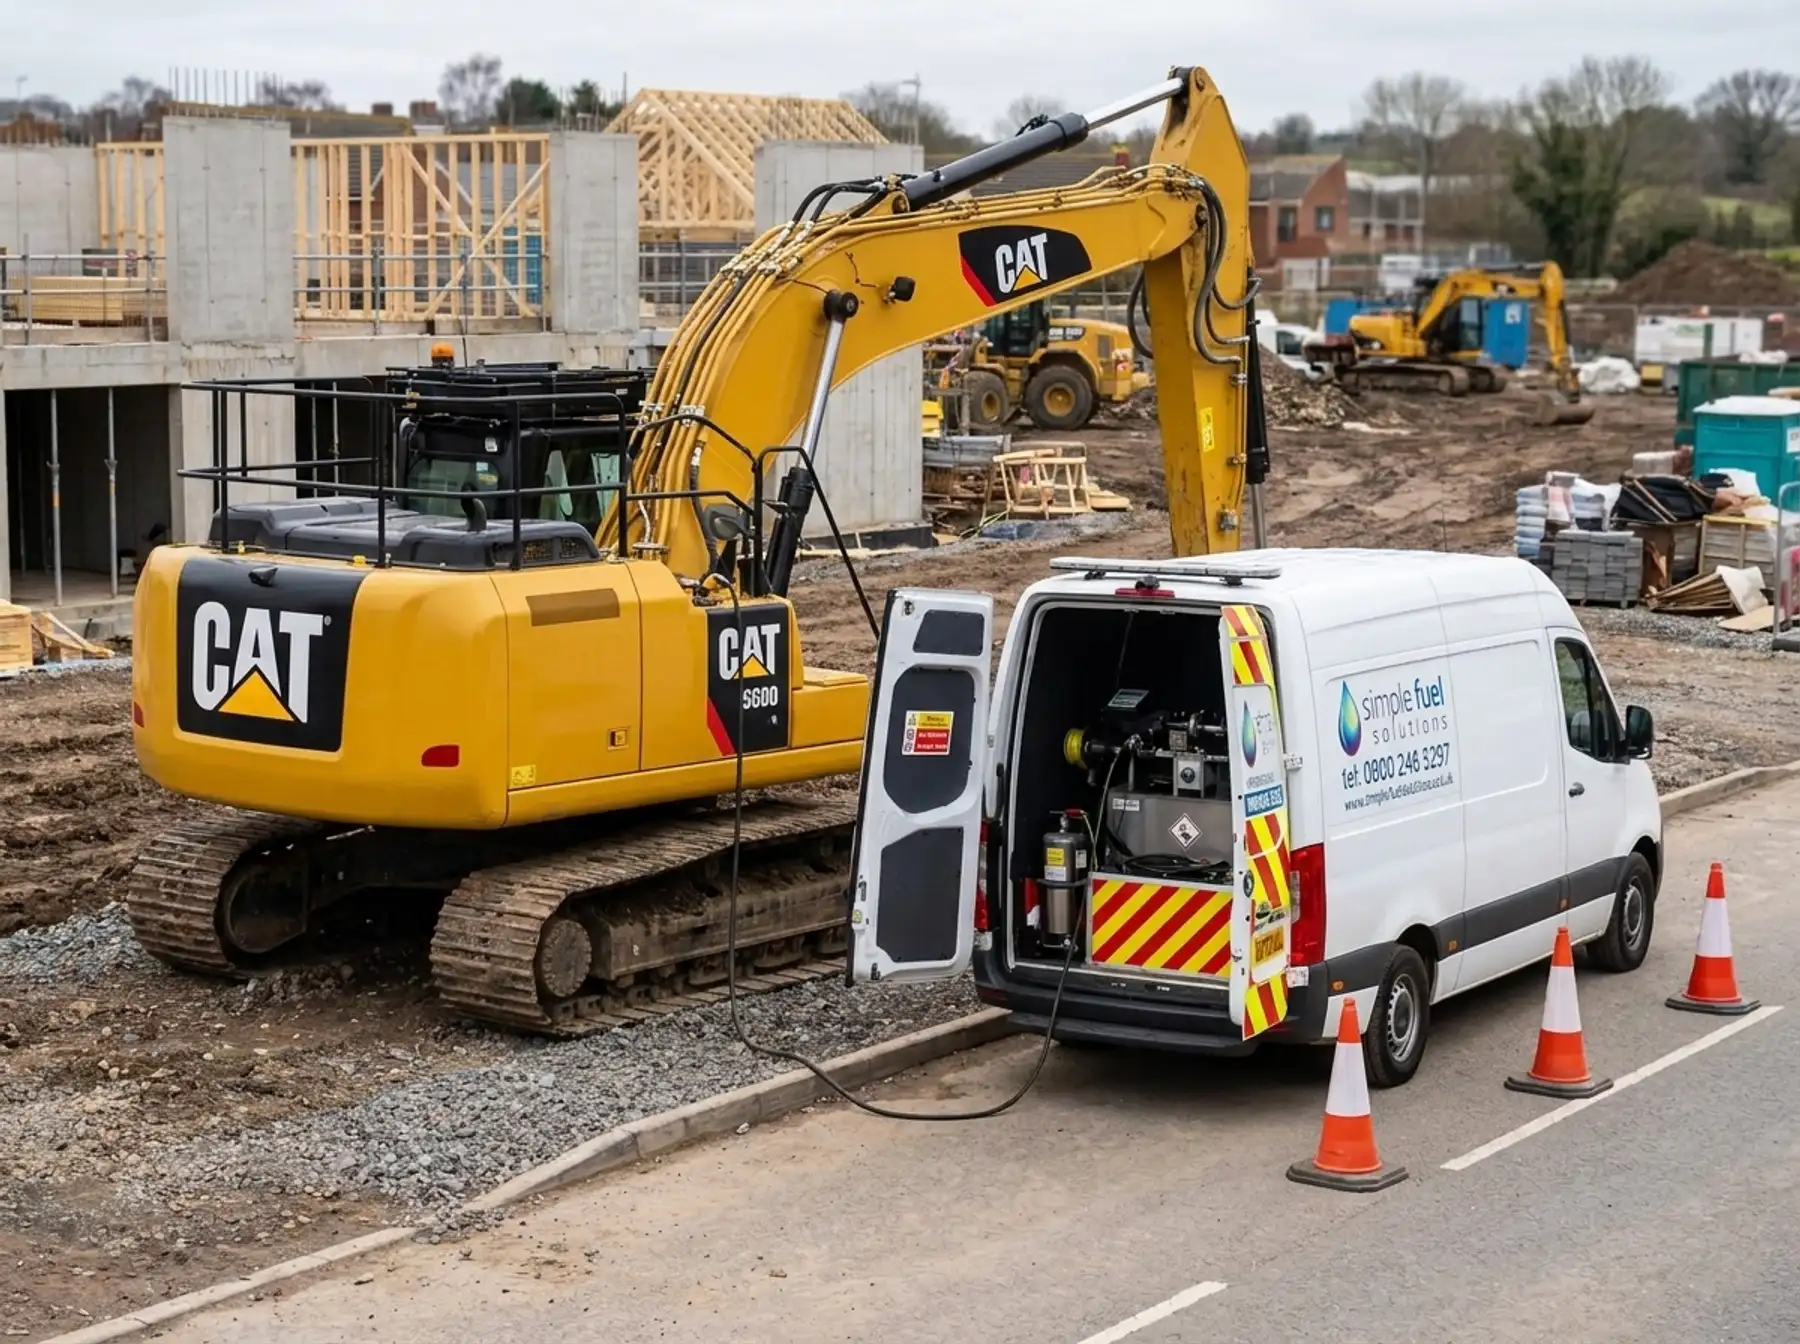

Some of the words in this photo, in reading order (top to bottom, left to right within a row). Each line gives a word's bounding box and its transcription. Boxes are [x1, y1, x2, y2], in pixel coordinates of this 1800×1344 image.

[995, 232, 1048, 293] CAT
[192, 601, 324, 724] CAT
[719, 623, 780, 680] CAT
[1362, 682, 1413, 721] simple
[1415, 675, 1445, 710] fuel
[1373, 714, 1448, 745] solutions
[1363, 755, 1395, 785] 0800
[1397, 750, 1420, 776] 246
